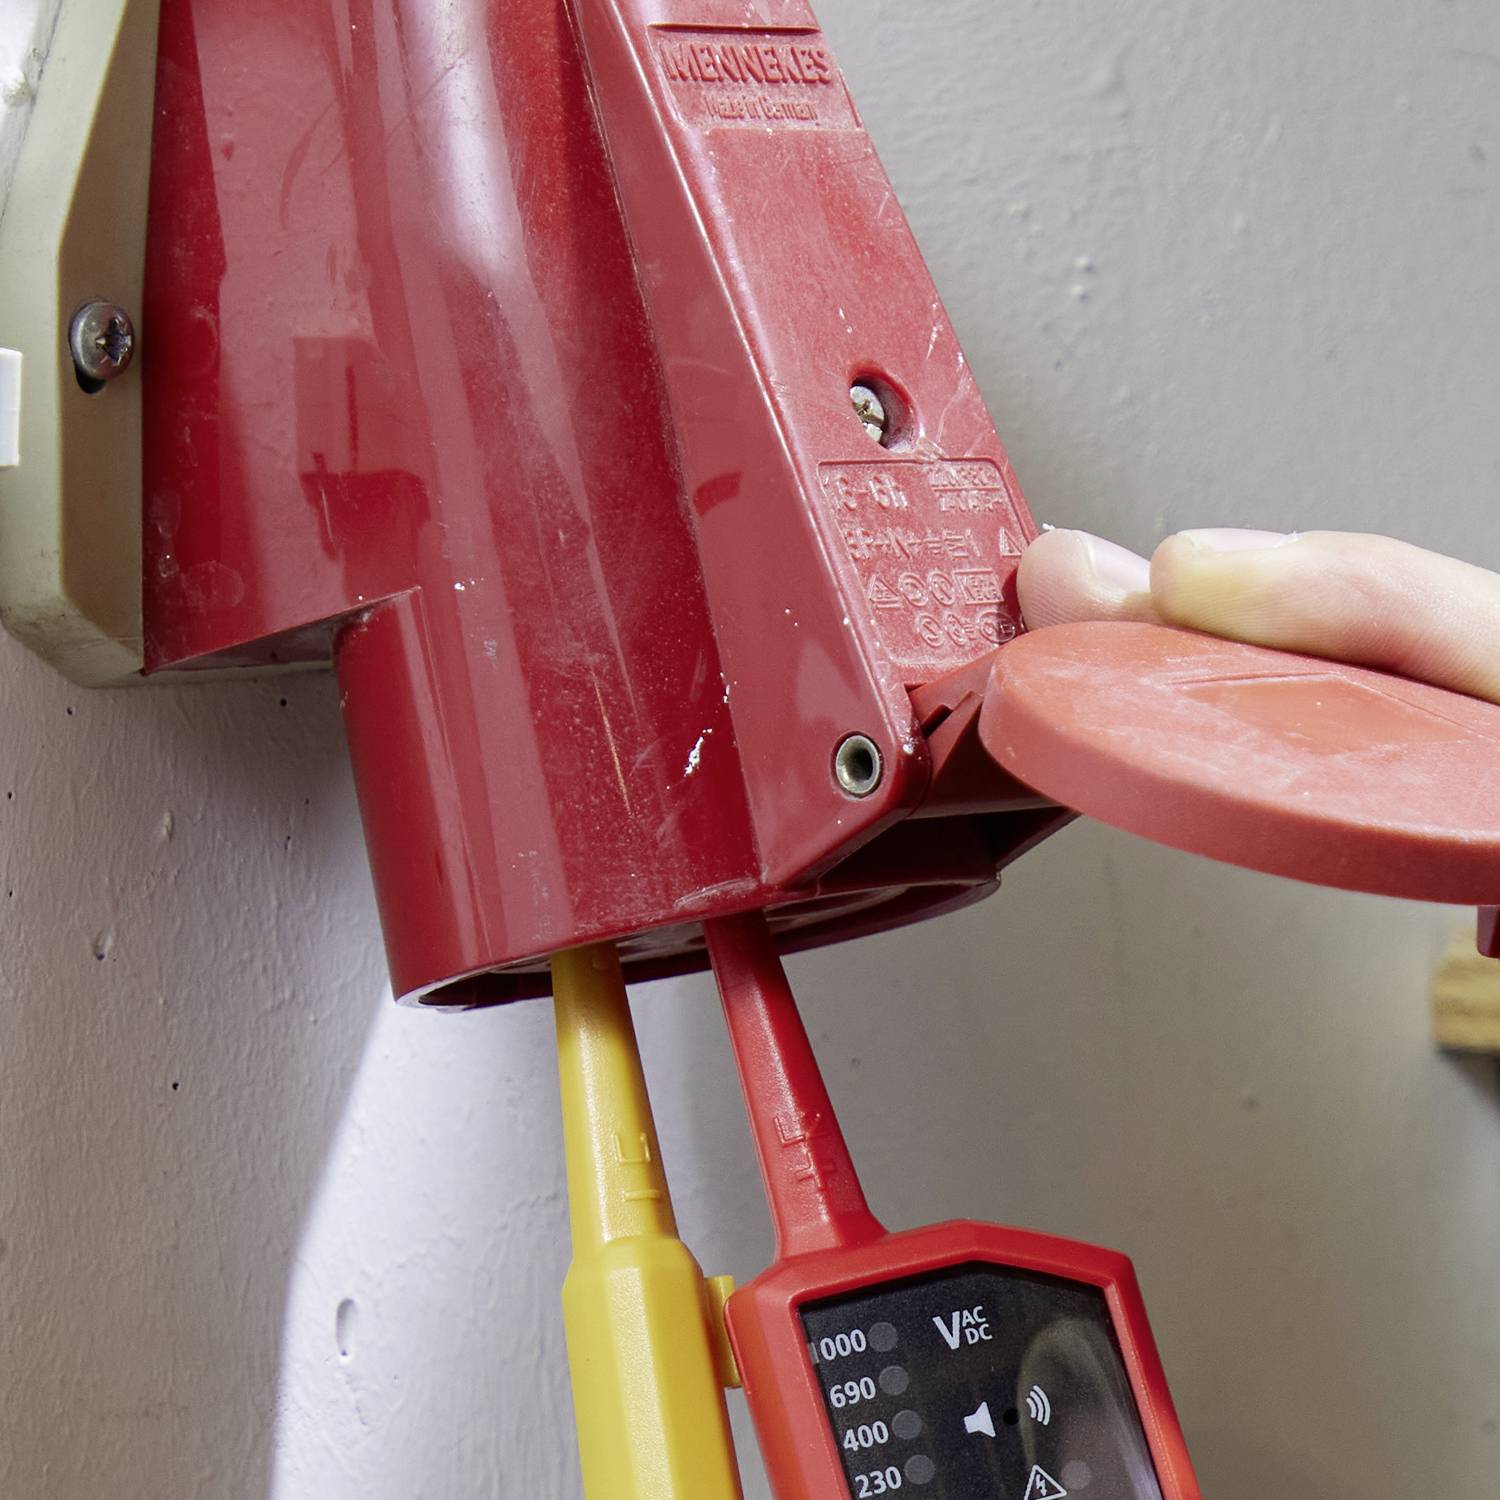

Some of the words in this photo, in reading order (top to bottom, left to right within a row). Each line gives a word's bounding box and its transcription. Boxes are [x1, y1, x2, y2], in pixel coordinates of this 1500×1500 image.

[658, 44, 832, 84] MENNEKES
[830, 1376, 876, 1408] 690
[843, 1420, 889, 1452] 400
[854, 1466, 902, 1499] 230
